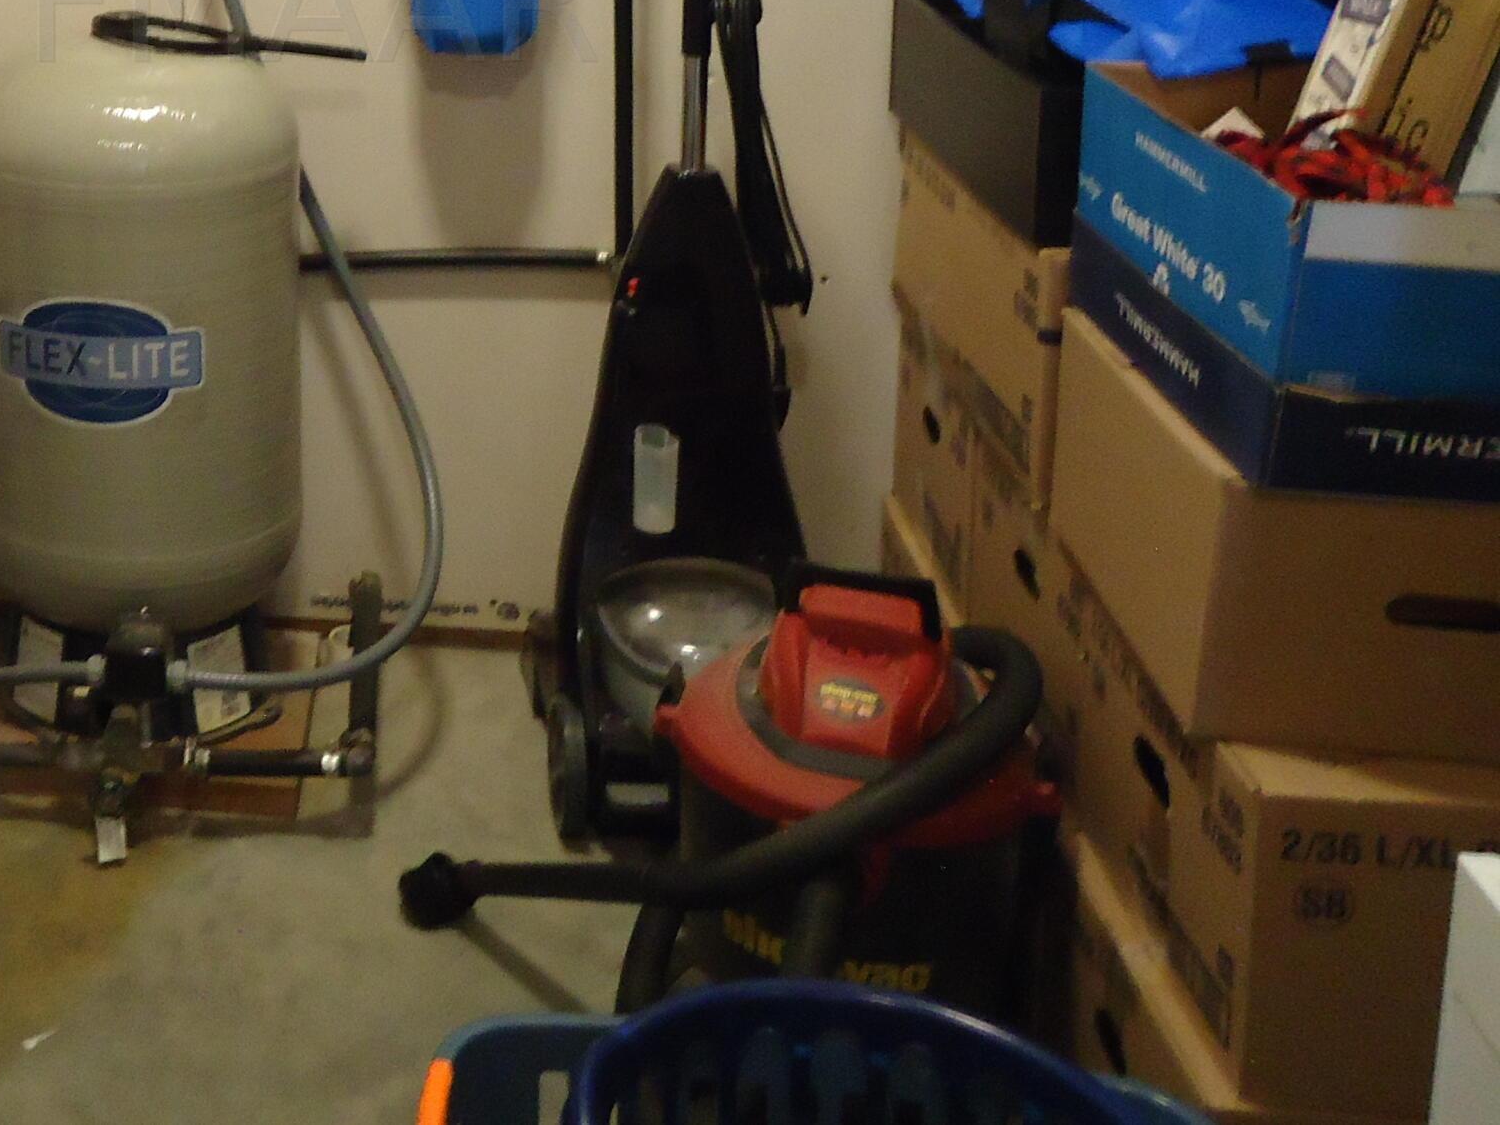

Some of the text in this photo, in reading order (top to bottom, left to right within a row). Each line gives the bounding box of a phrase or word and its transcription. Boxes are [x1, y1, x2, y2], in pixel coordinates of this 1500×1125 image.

[1111, 191, 1150, 245] Great
[1152, 224, 1199, 281] White
[7, 330, 190, 381] FLEX-LITE
